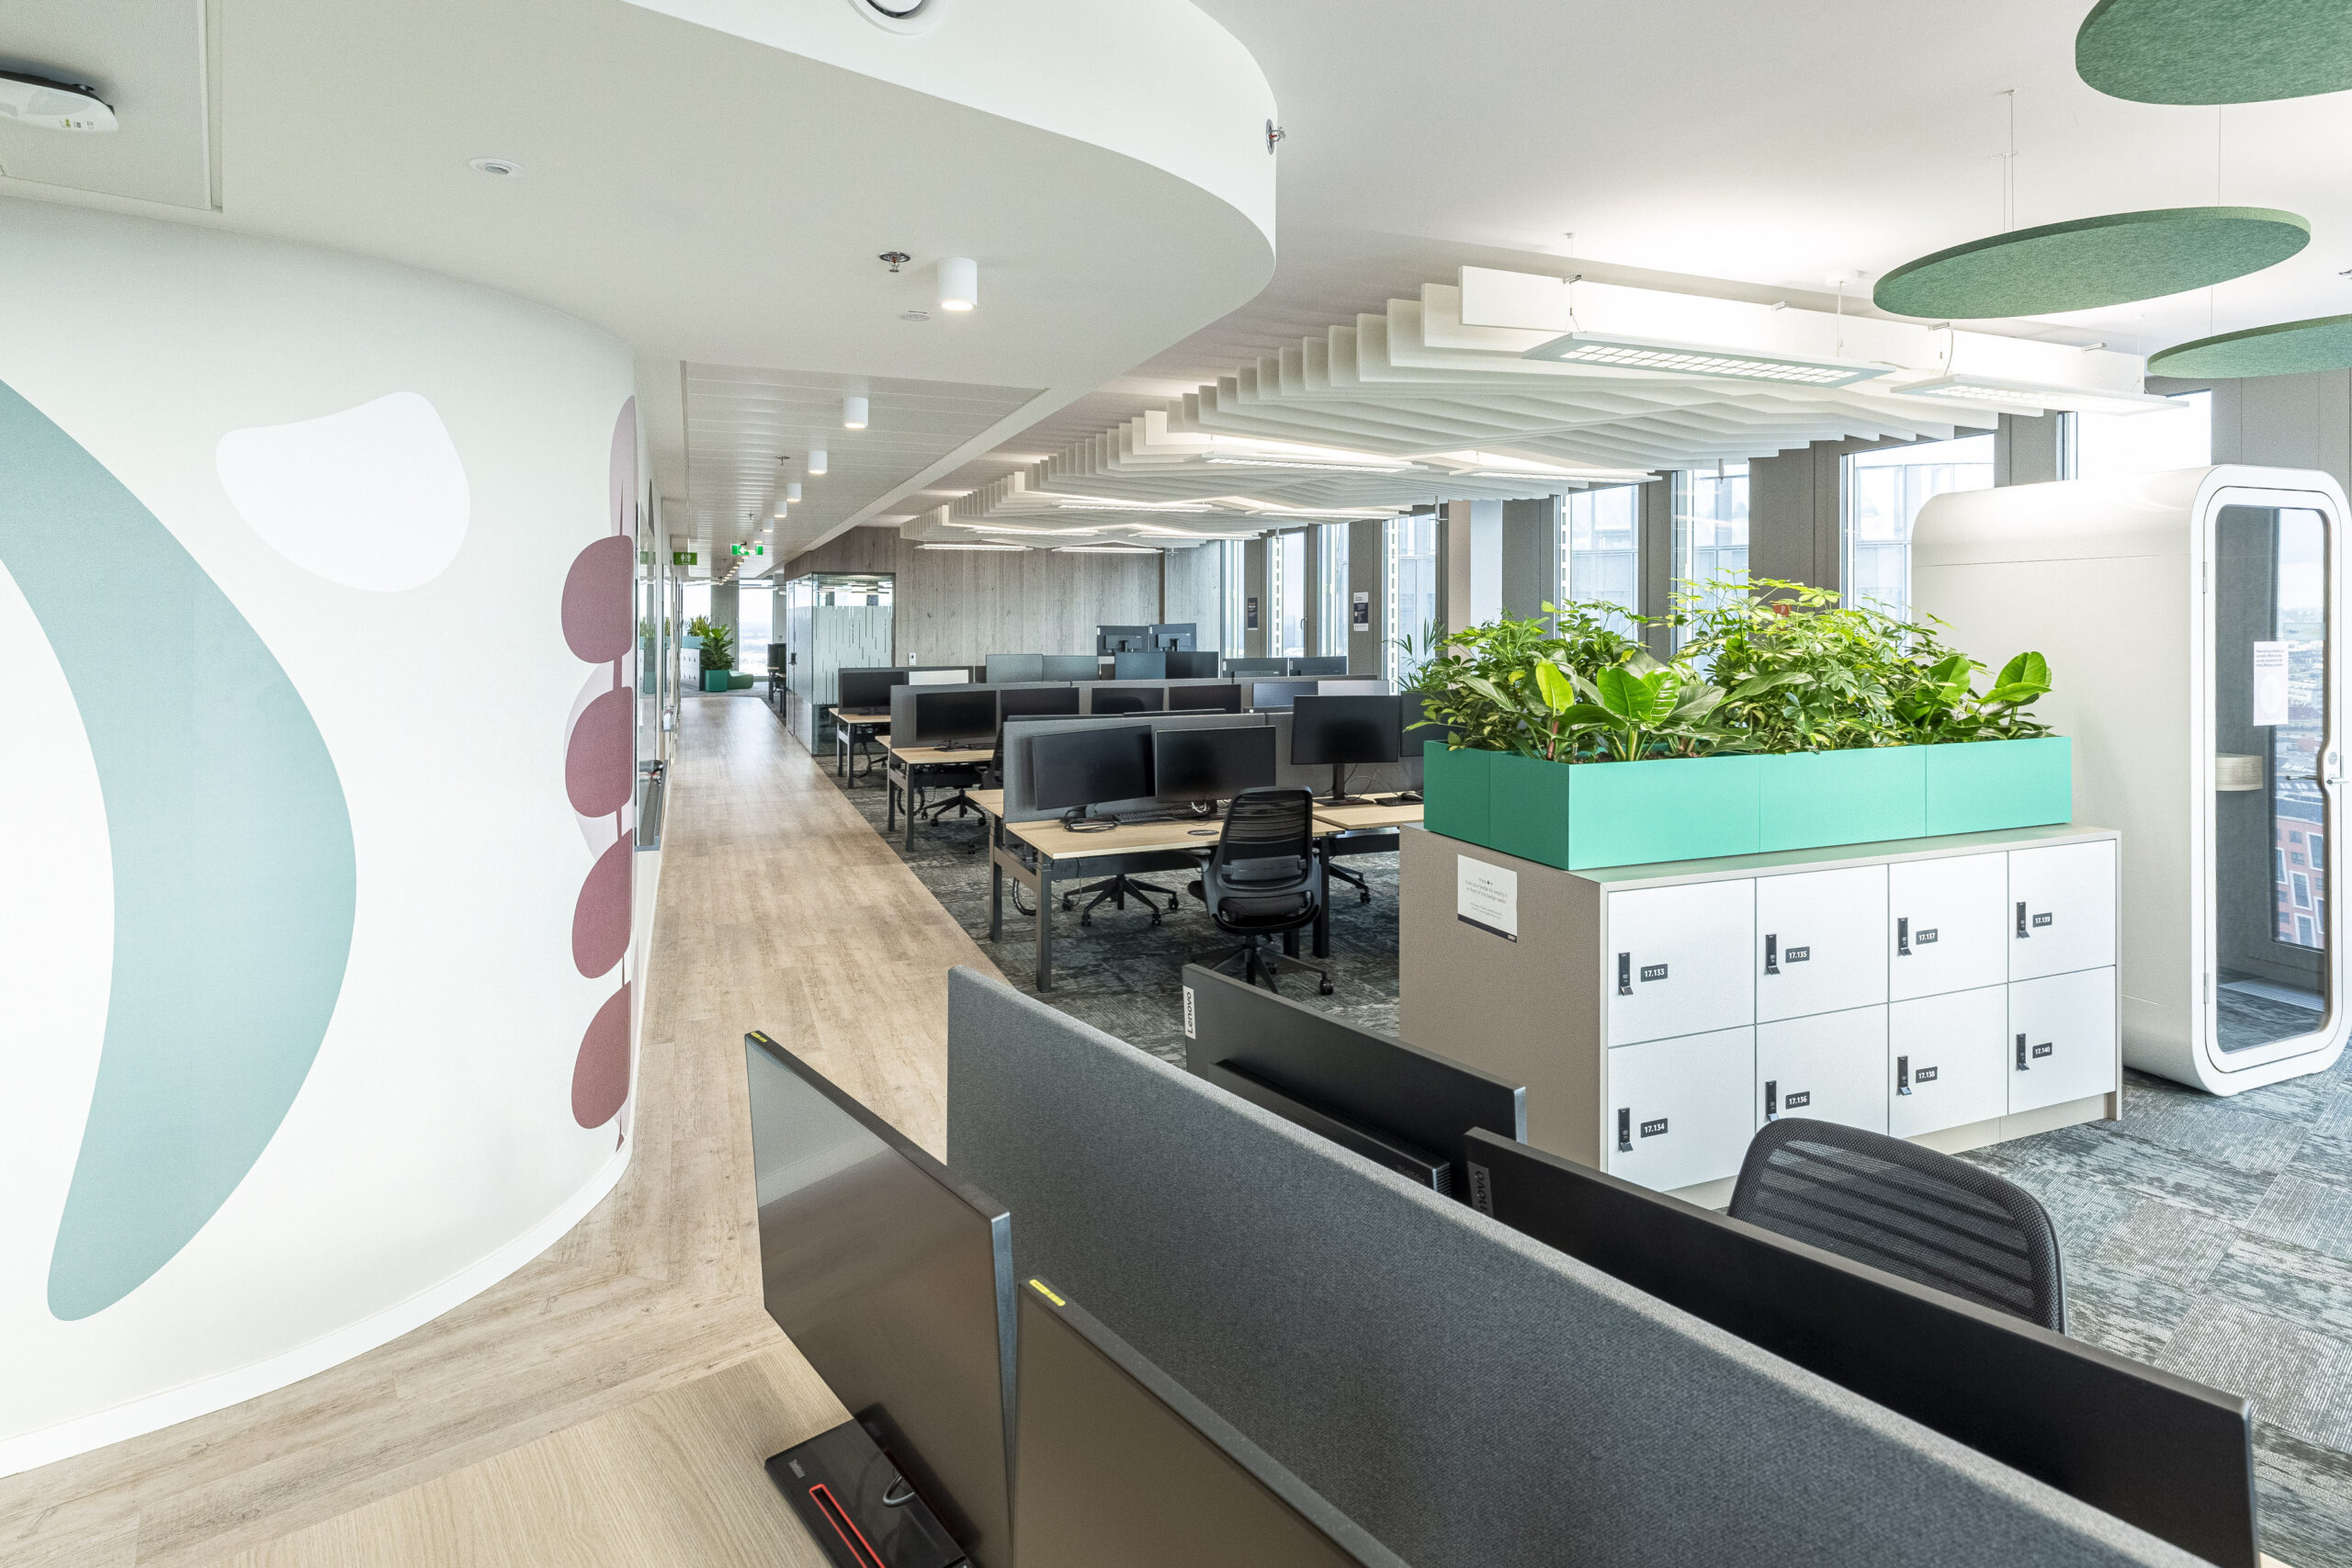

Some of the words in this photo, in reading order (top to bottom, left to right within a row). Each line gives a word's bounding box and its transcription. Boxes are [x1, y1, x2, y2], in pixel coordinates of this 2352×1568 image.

[2035, 916, 2051, 924] 17.139
[1918, 932, 1936, 941] 17.137
[1789, 951, 1807, 959] 17.135
[1645, 968, 1665, 977] 17.133
[2035, 1046, 2051, 1055] 17.140
[1918, 1070, 1935, 1079] 17.138
[1789, 1096, 1807, 1105] 17.136
[1645, 1122, 1665, 1133] 17.134
[1475, 1170, 1487, 1213] novo
